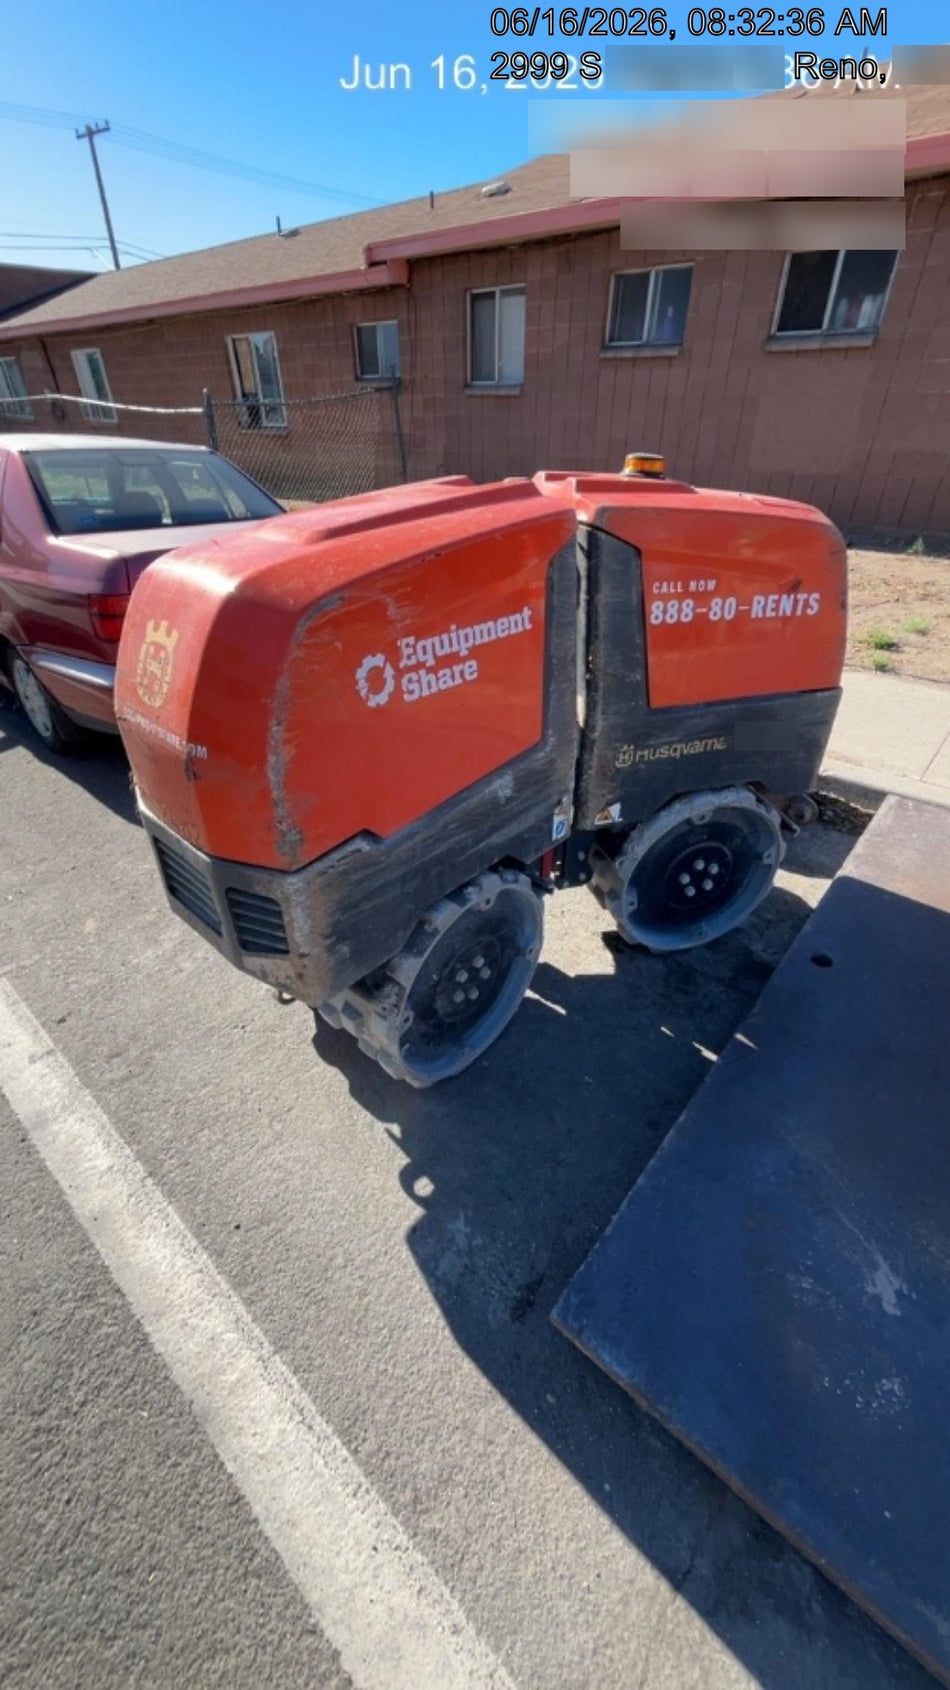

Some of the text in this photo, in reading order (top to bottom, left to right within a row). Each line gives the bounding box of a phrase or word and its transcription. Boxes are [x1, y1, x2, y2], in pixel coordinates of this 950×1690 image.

[653, 579, 717, 594] CALL NOW
[650, 592, 821, 625] 888-80-RENTS
[399, 606, 533, 668] Equipment
[401, 659, 478, 702] Share
